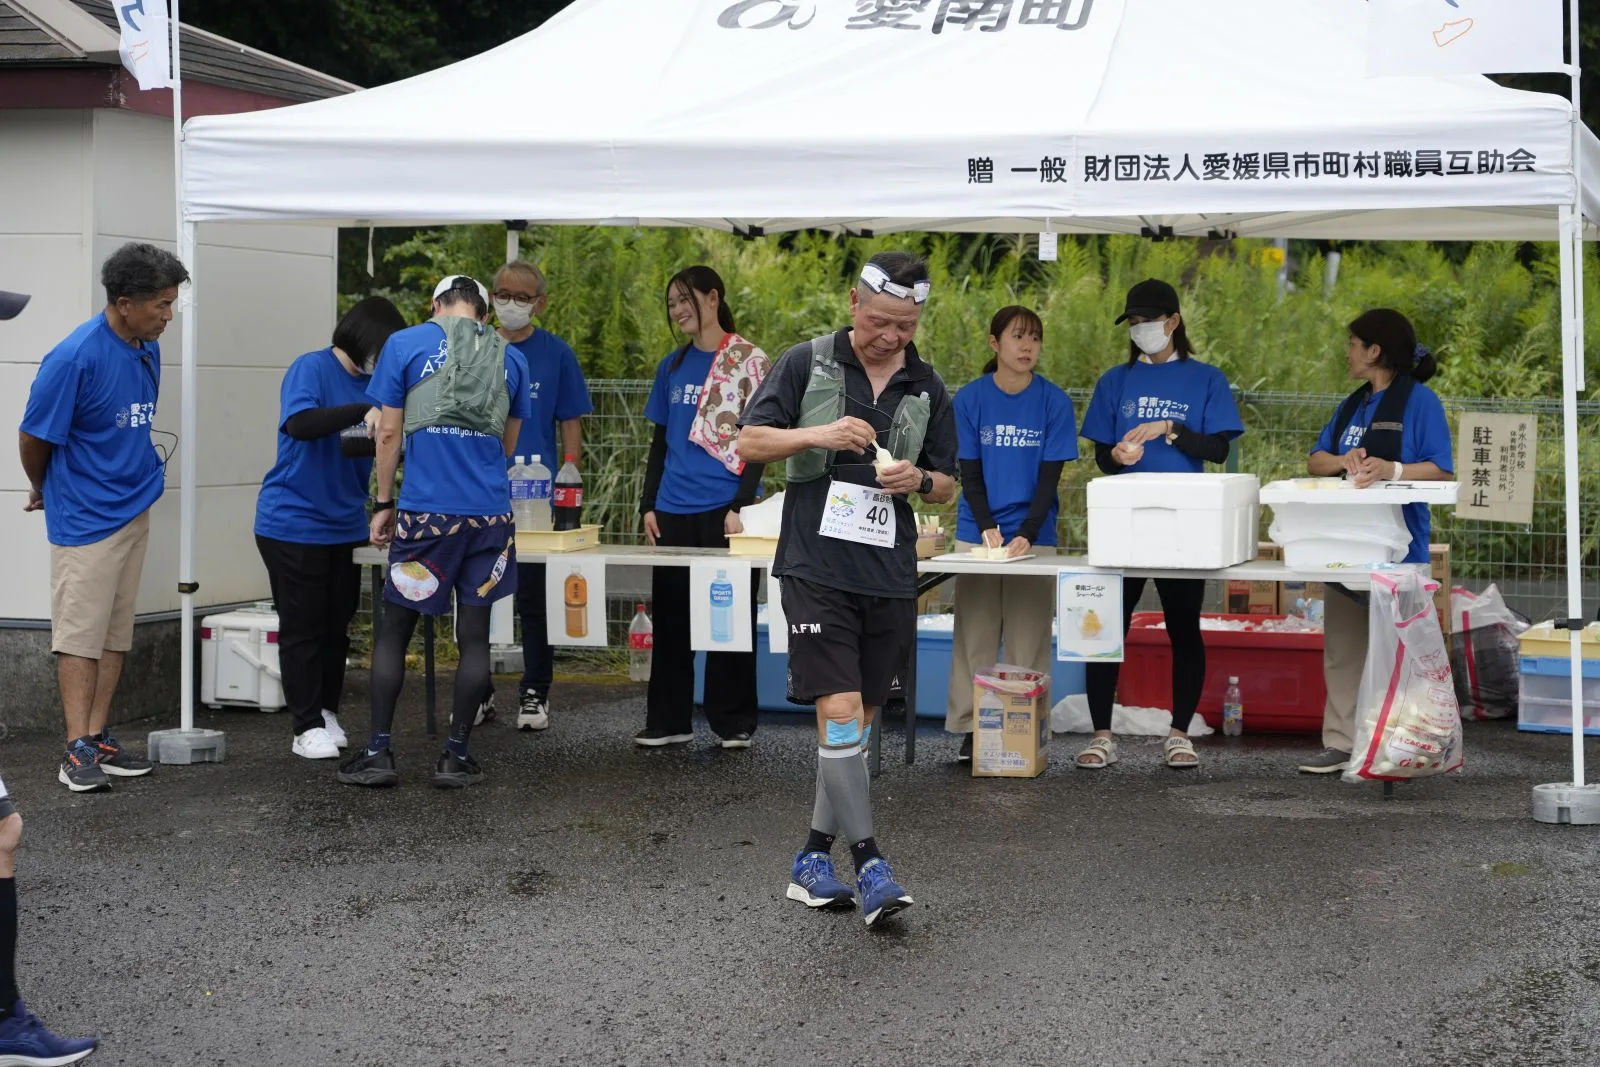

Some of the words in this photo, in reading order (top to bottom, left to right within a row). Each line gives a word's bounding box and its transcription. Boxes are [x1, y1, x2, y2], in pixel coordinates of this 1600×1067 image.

[967, 156, 994, 184] 贈
[1010, 156, 1067, 183] 一般
[1083, 147, 1537, 182] 財団法人愛媛県市町村職員互助会
[1137, 407, 1169, 418] 2026
[995, 424, 1042, 437] 愛南マラニッ
[995, 436, 1026, 447] 2026
[1470, 426, 1493, 508] 駐車禁止
[866, 505, 889, 526] 40
